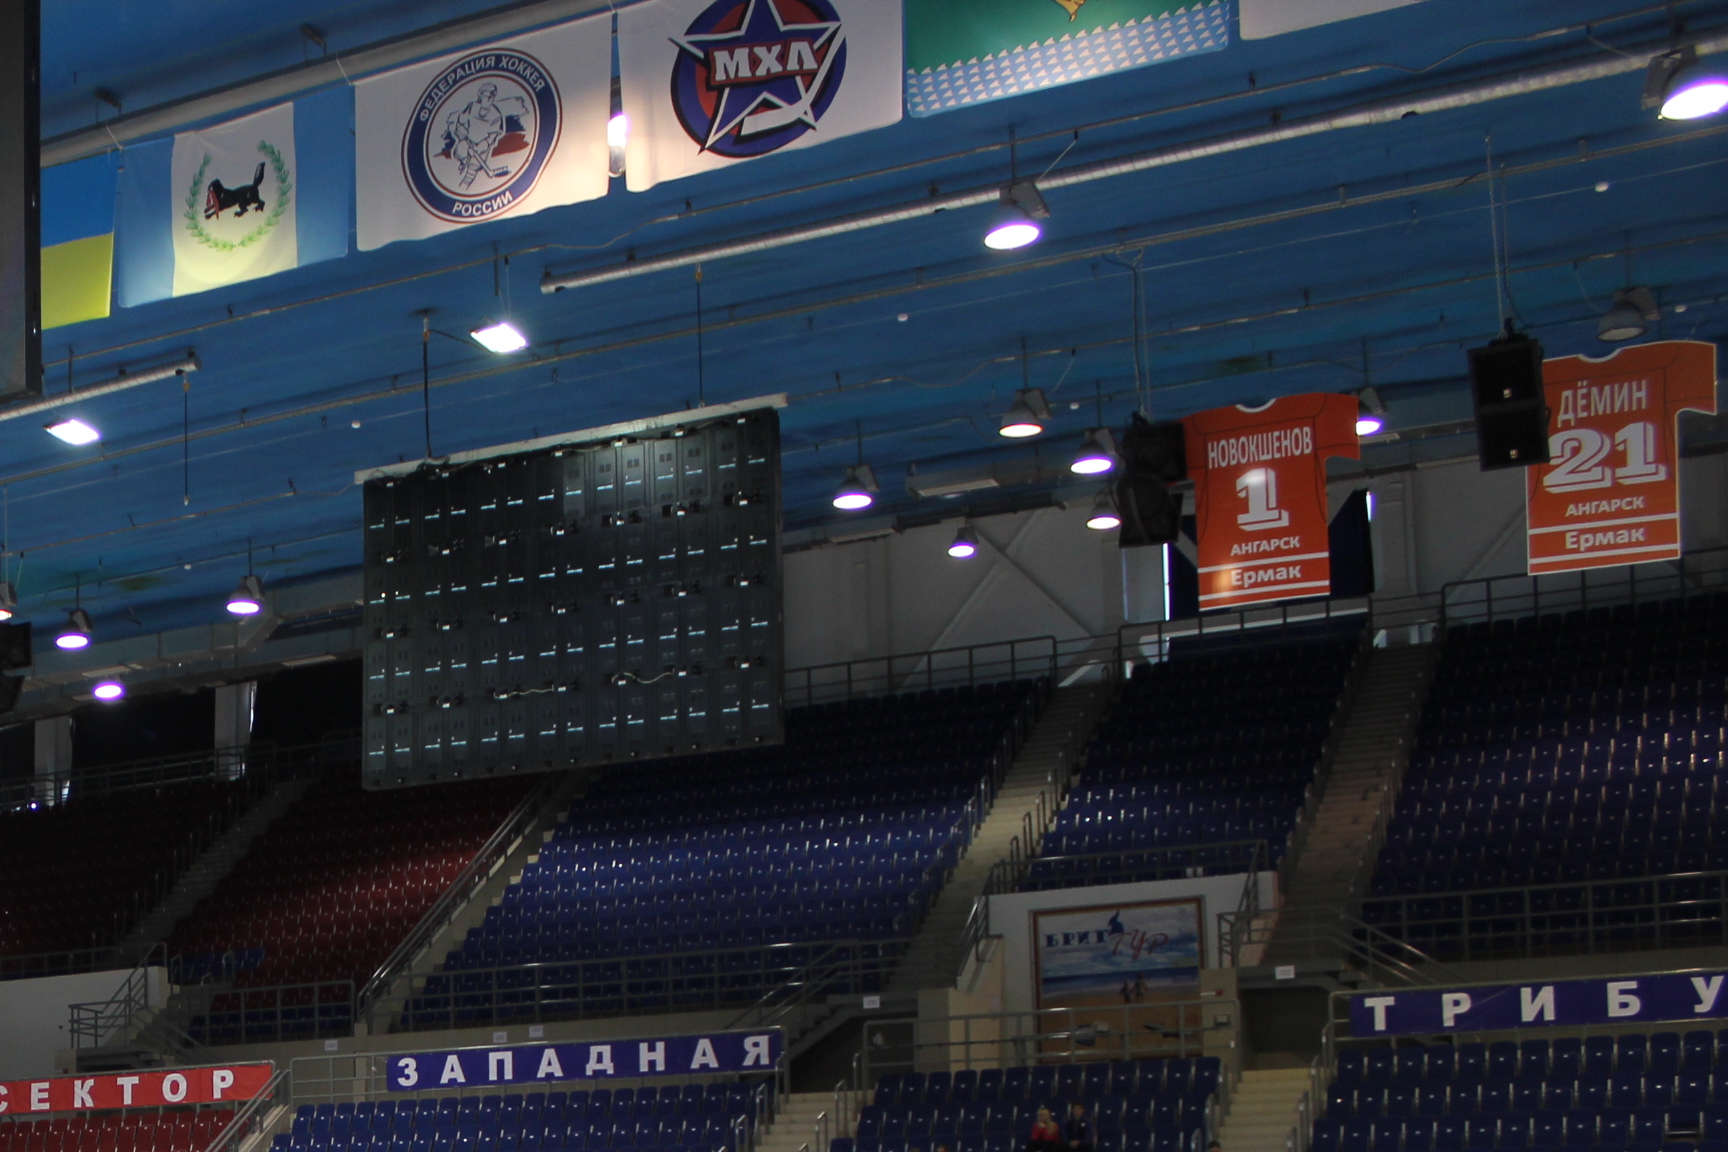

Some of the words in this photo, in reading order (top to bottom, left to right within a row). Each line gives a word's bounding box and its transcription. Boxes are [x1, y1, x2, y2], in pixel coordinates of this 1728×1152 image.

[713, 41, 818, 81] МХЛ
[419, 56, 496, 121] ФЕДЕРАЦИЯ
[499, 55, 546, 92] ХОККЕЯ
[452, 190, 513, 216] РОССИИ
[1557, 379, 1647, 429] ДЁМИН
[1208, 427, 1312, 469] НОВОКШЕНОВ
[1543, 422, 1666, 494] 21
[1236, 467, 1289, 532] 1
[1565, 496, 1645, 517] АНГАРСК
[1230, 536, 1300, 557] АНГАРСК
[1565, 527, 1645, 551] Ермак
[1231, 565, 1301, 588] Ермак
[395, 1034, 770, 1087] ЗАПАДНАЯ
